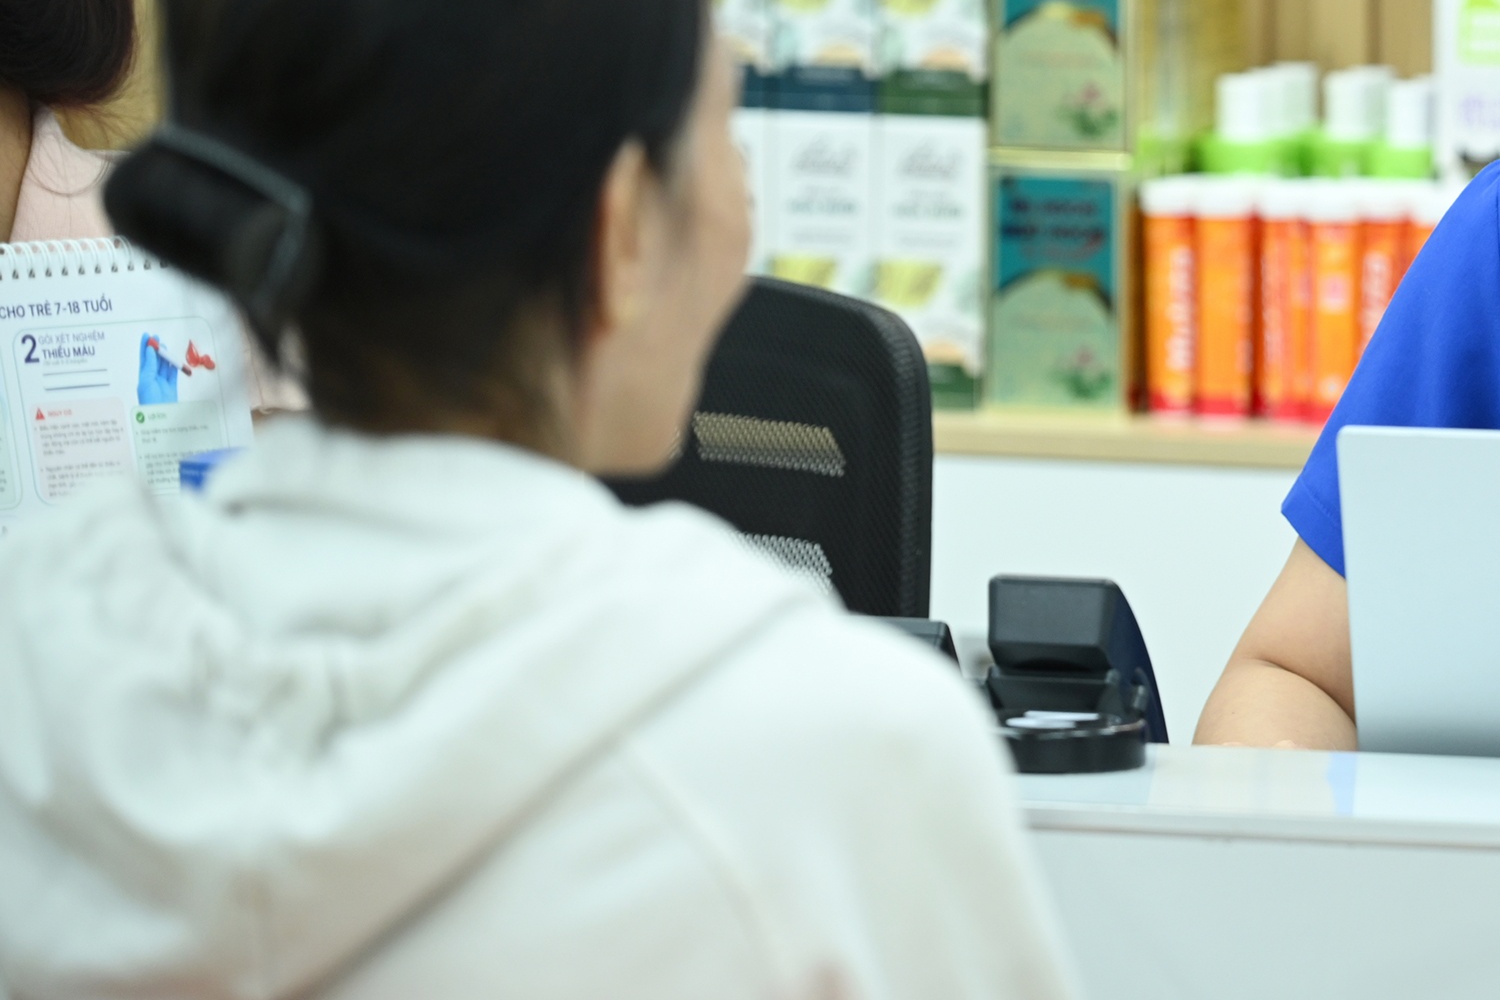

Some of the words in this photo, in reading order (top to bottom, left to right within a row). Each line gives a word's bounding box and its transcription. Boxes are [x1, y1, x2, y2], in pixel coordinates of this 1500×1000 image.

[0, 304, 25, 319] CHO
[54, 301, 81, 316] 7-18
[21, 334, 40, 364] 2
